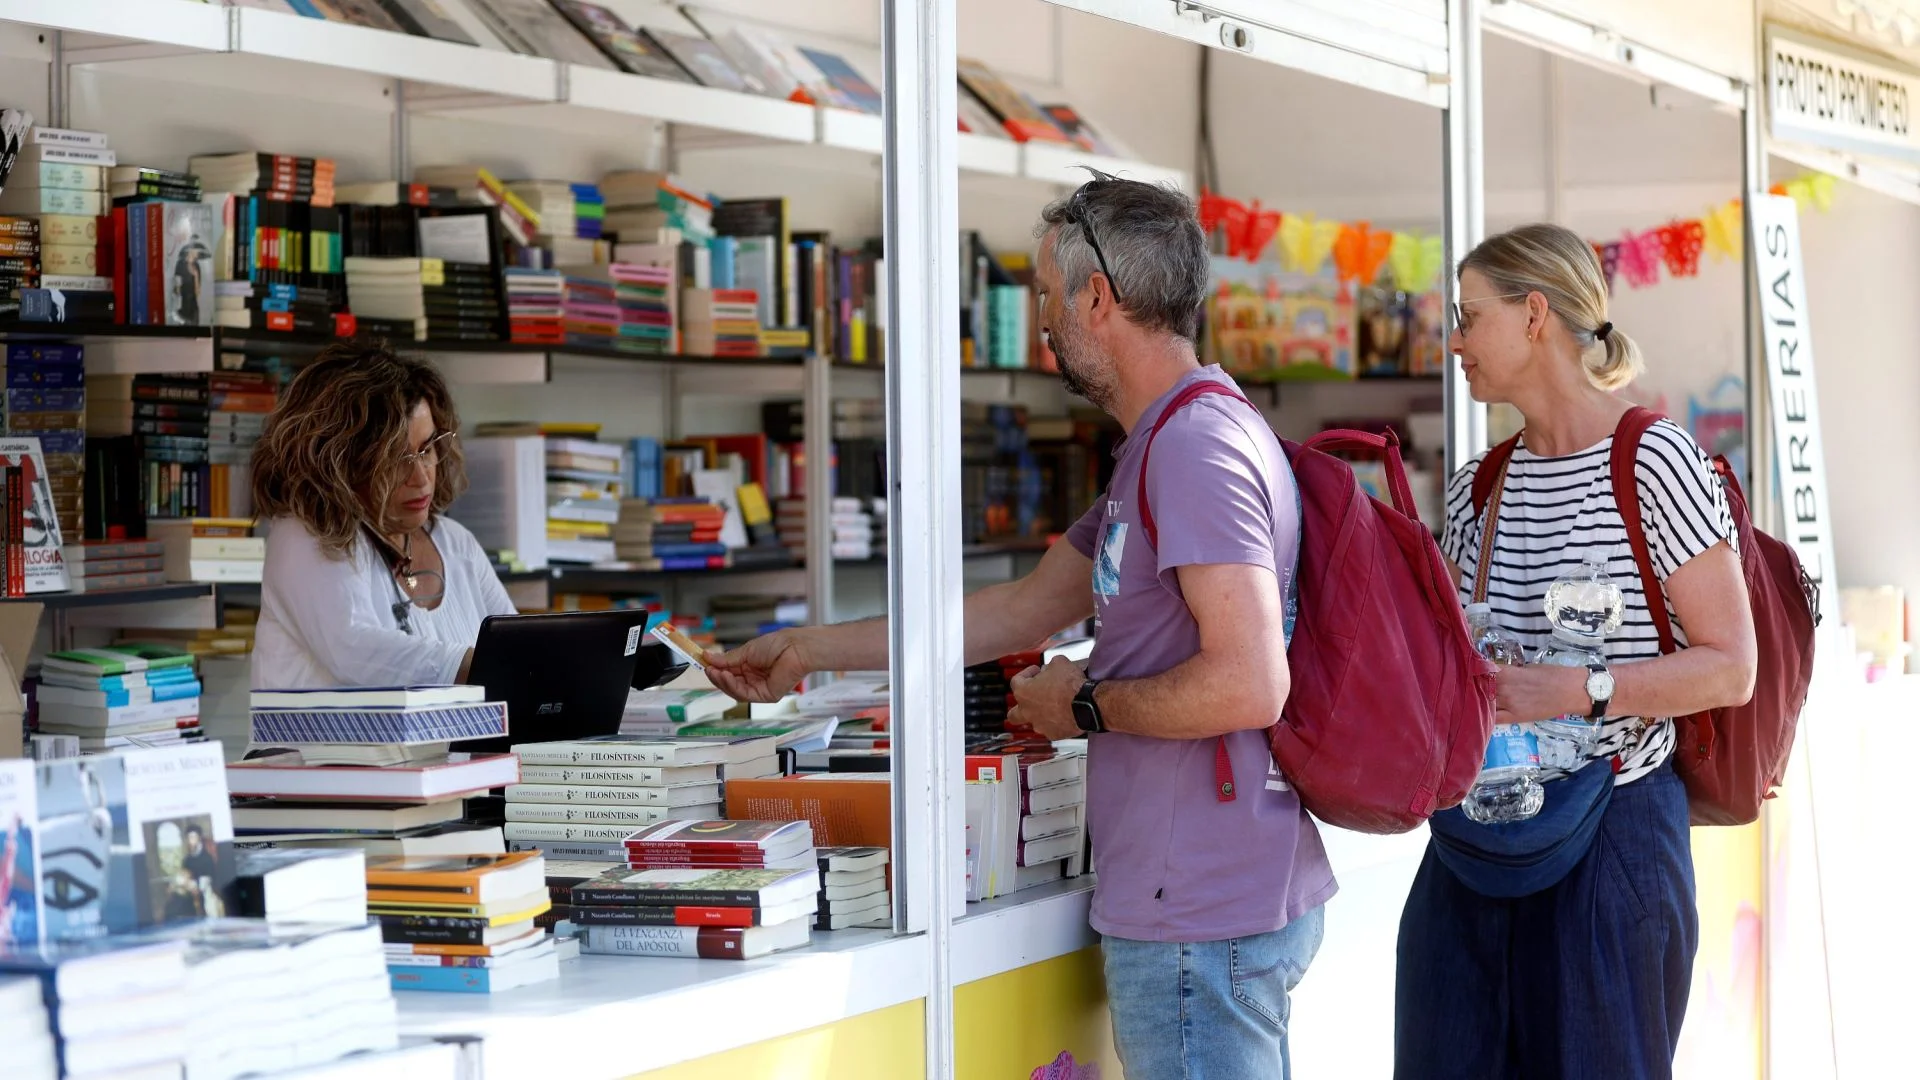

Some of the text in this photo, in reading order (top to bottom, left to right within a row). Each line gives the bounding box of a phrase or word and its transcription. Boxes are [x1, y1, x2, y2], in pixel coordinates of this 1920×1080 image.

[1776, 52, 1909, 137] PROTEO PROMETEO
[1765, 222, 1823, 584] LIBRERÍAS
[537, 702, 563, 714] ASUS
[591, 750, 646, 761] FILOSÍNTESIS
[581, 770, 634, 781] FILOSÍNTESIS
[585, 789, 640, 800] FILOSÍNTESIS
[585, 809, 639, 820] FILOSÍNTESIS
[613, 927, 683, 939] LA VENGANZA
[616, 939, 681, 952] DEL APÓSTOL
